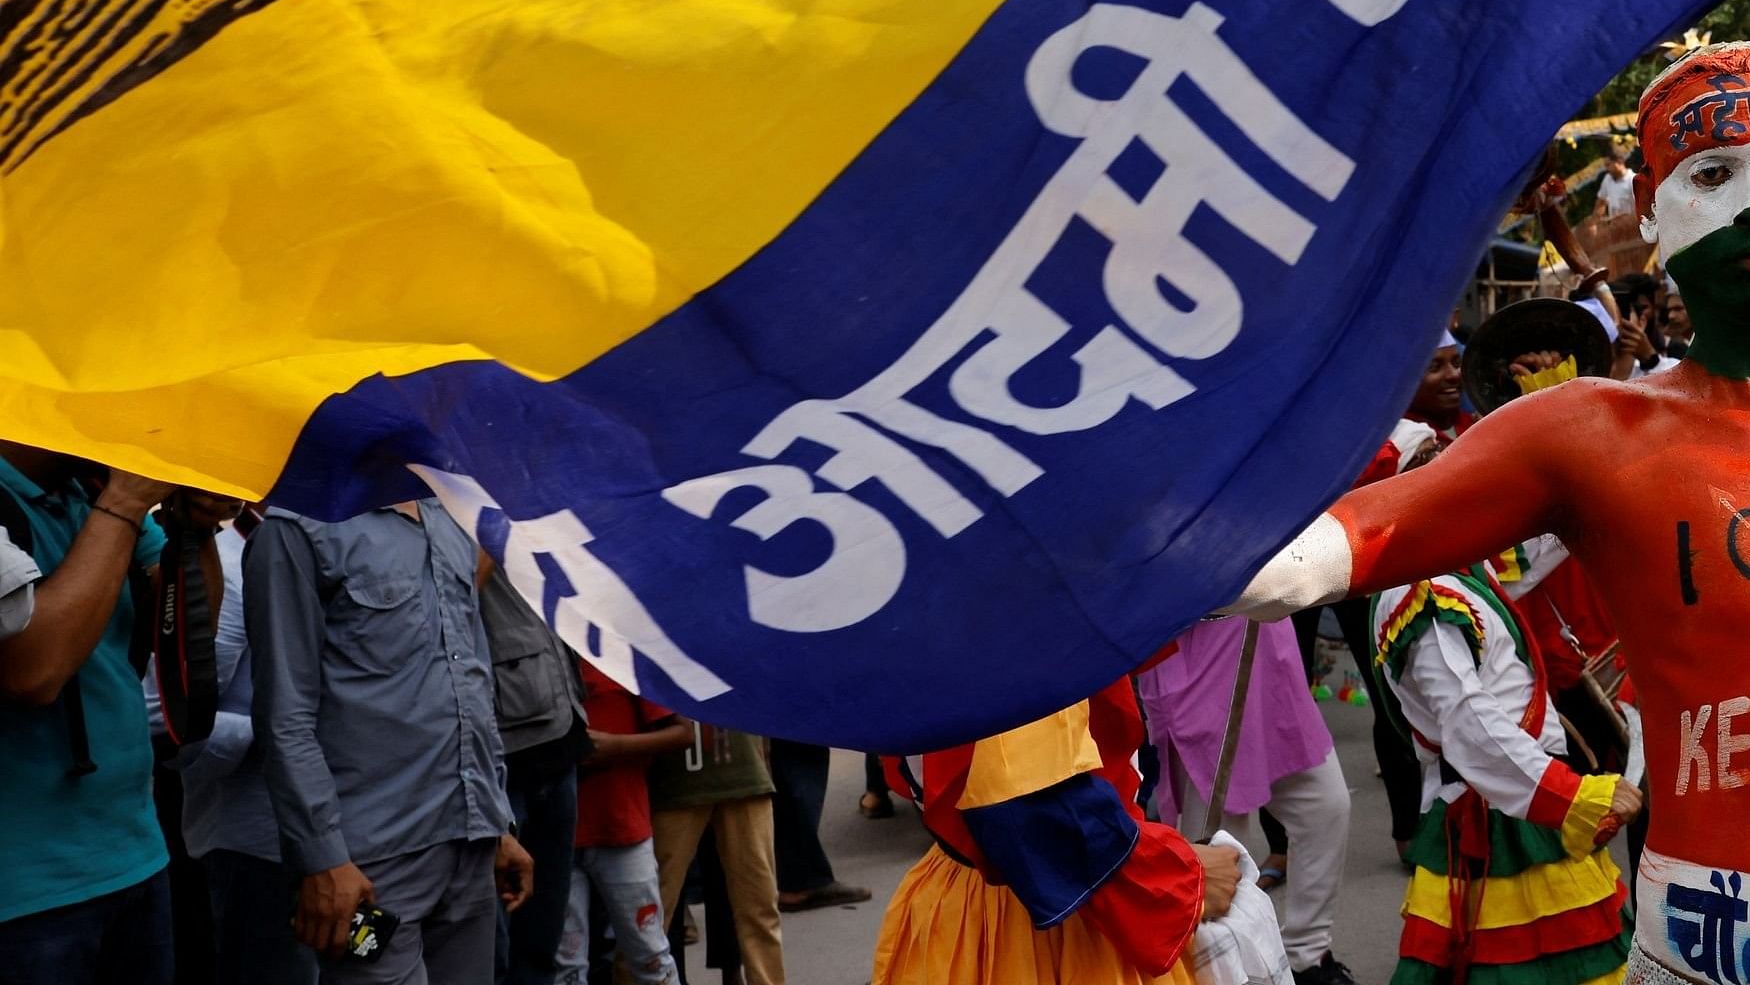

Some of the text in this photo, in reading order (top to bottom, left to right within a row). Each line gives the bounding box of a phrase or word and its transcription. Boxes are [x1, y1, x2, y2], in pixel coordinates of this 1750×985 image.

[662, 1, 1355, 633] आदमी
[1676, 520, 1699, 606] I
[162, 583, 176, 635] Canon
